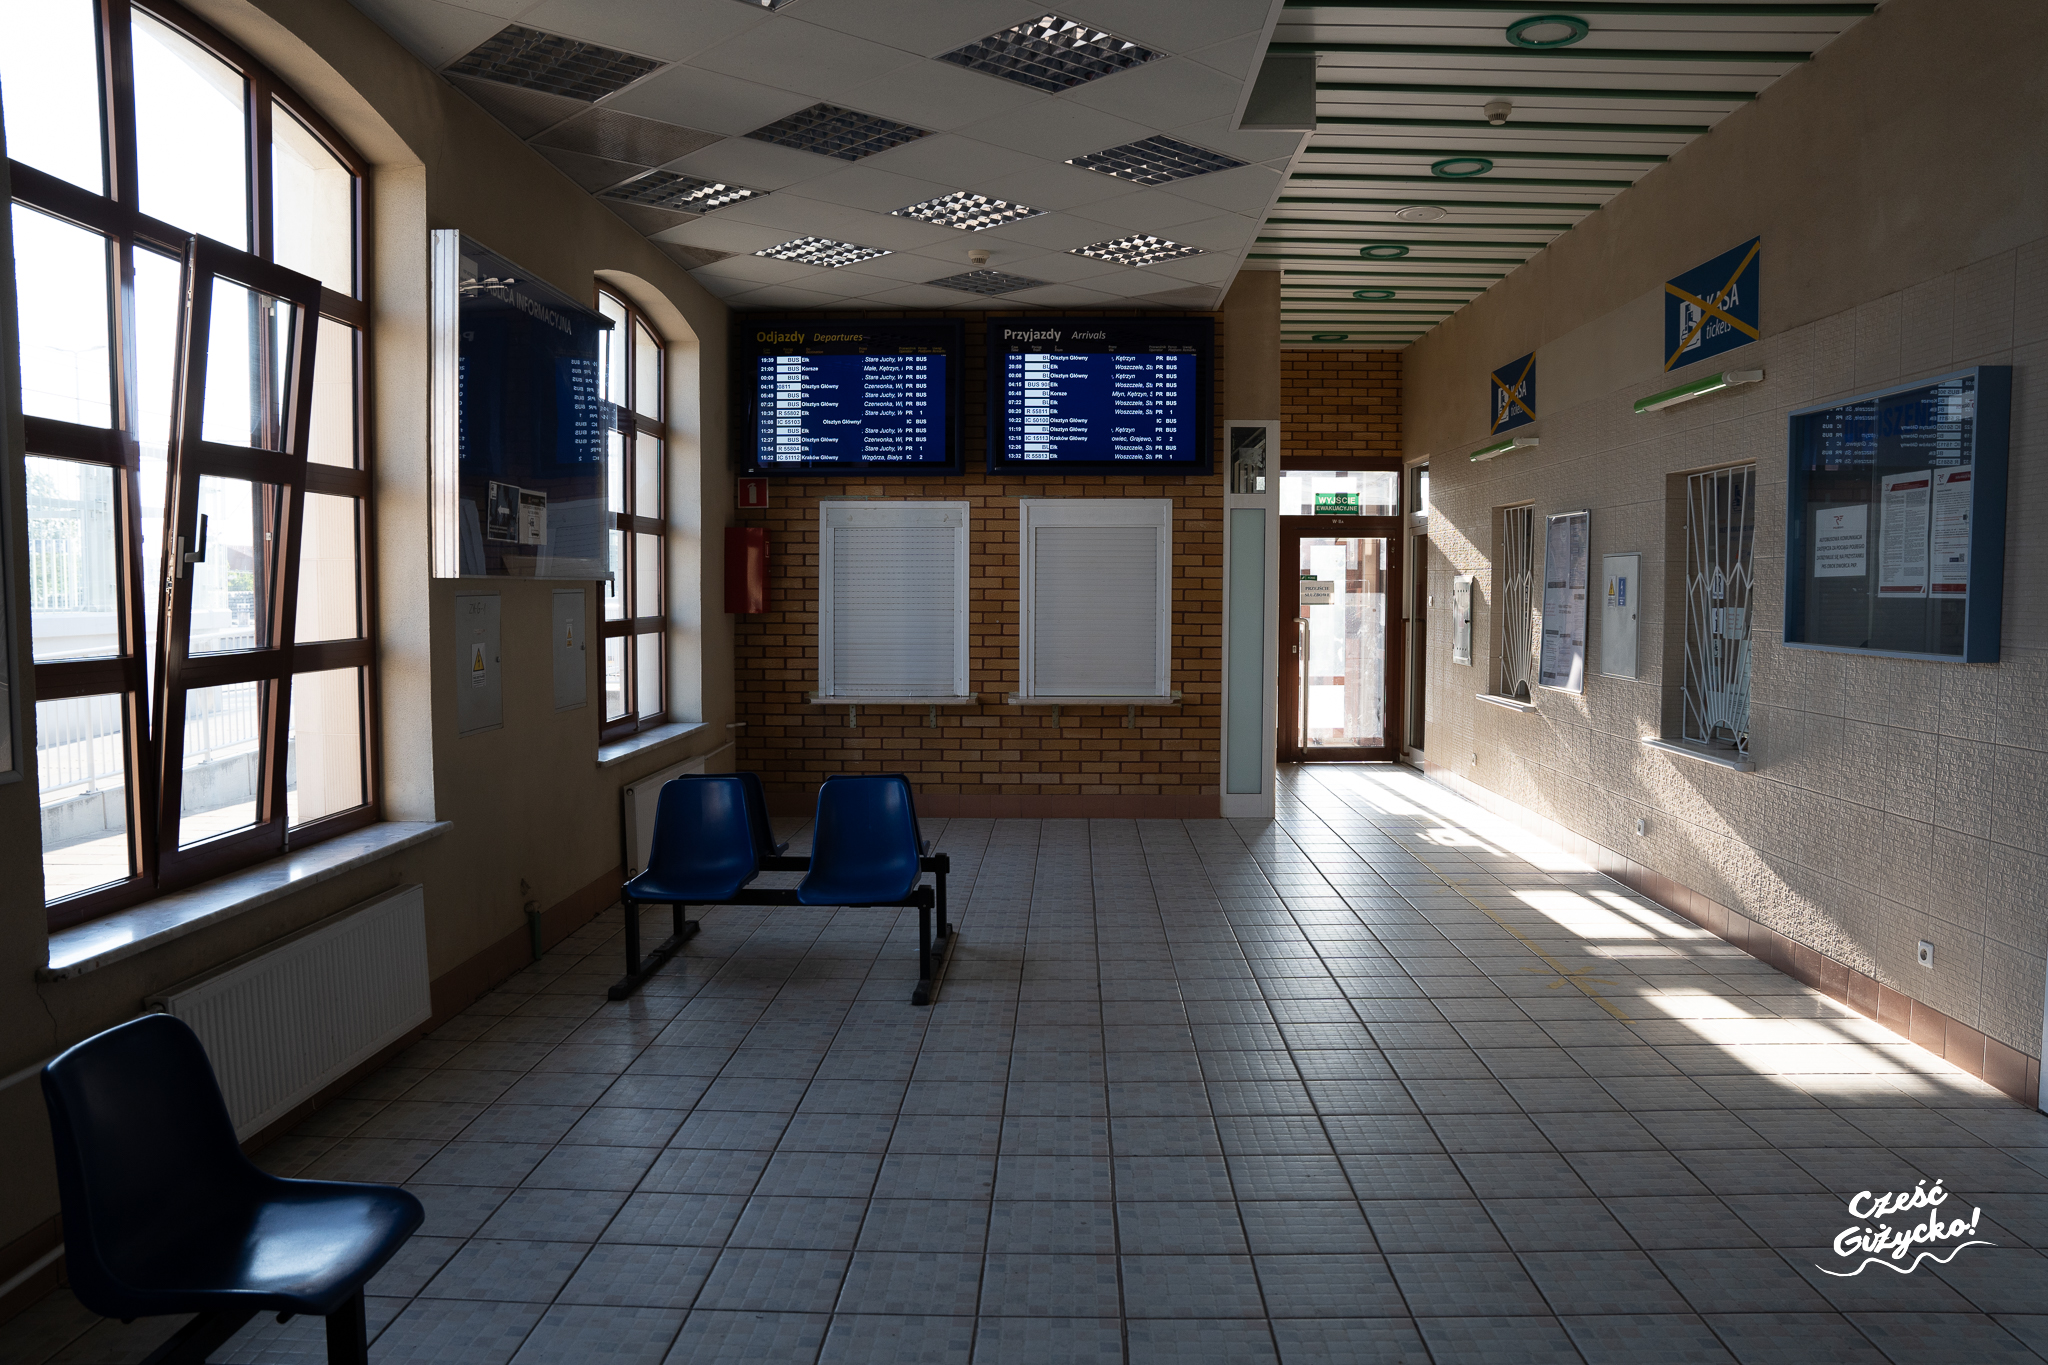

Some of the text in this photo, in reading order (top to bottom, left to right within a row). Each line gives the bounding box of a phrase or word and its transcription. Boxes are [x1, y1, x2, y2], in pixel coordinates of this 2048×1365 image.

[516, 292, 572, 335] INFORMACYJNA
[1004, 328, 1106, 342] Przyjazdy Arrivals
[1705, 318, 1732, 340] tickets
[756, 330, 864, 344] Odjazdy Departures
[1318, 495, 1356, 505] WYJŚCIE
